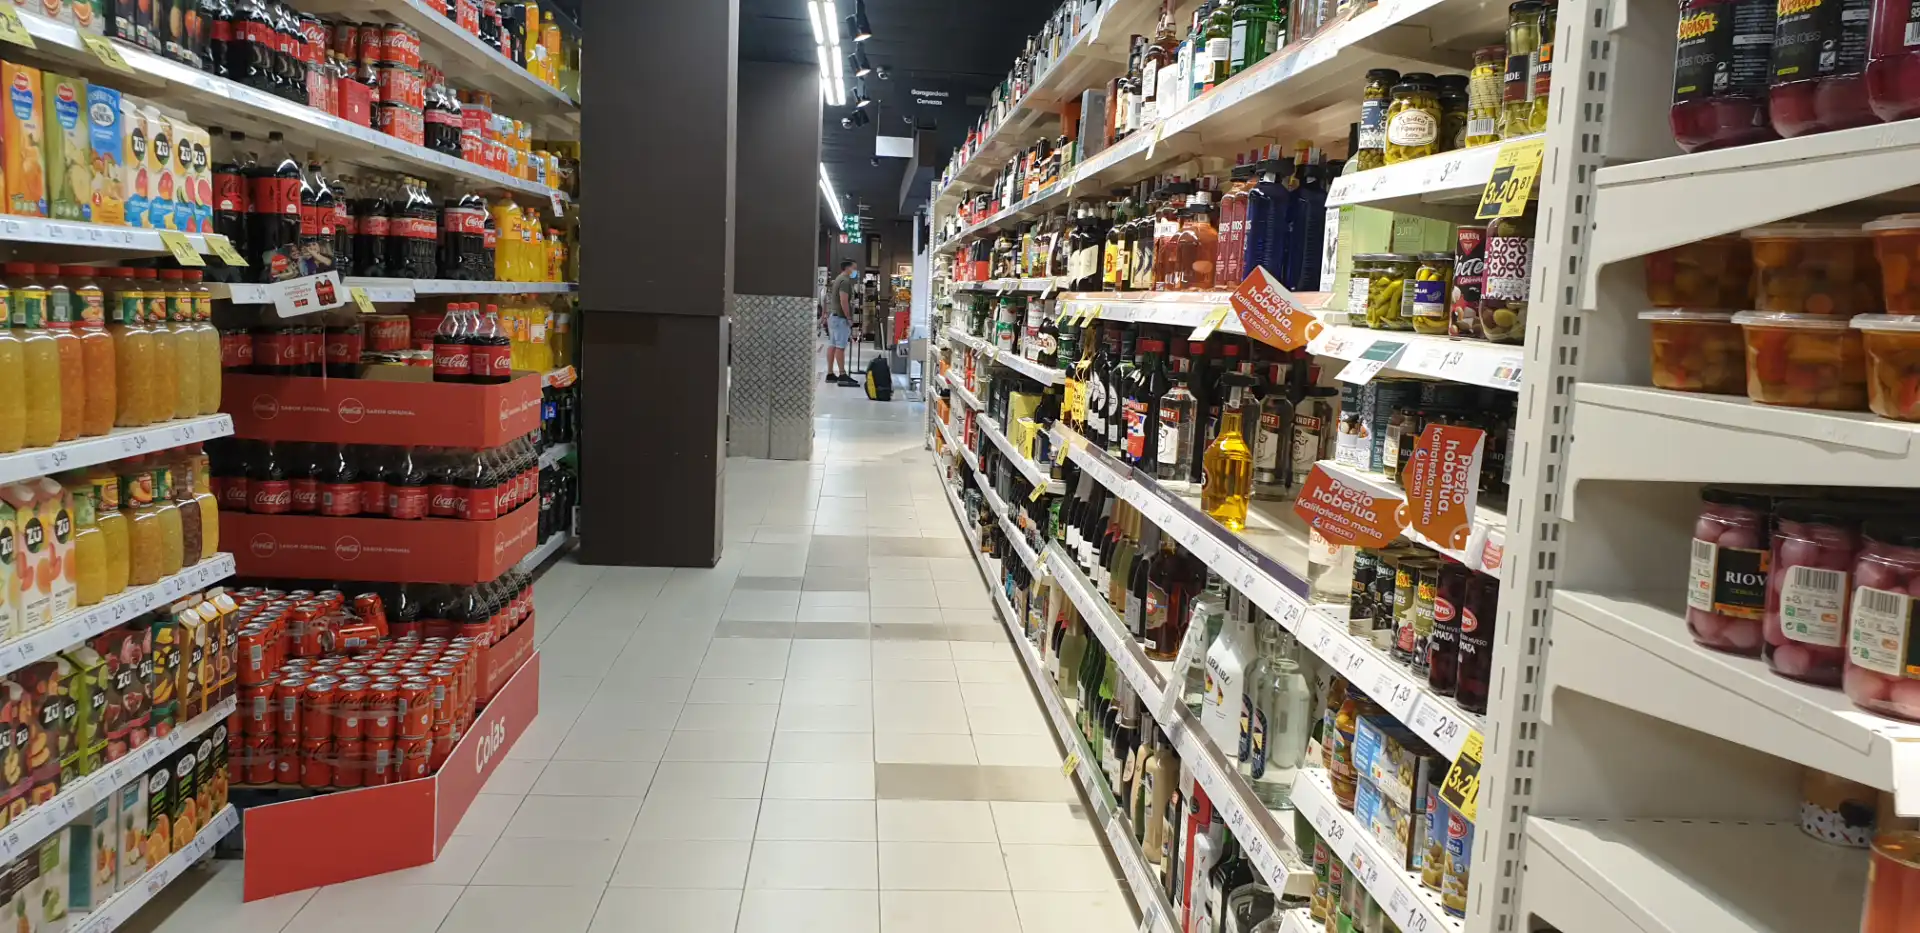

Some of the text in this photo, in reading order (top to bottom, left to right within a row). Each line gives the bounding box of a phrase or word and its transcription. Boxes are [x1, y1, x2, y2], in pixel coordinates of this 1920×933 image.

[1234, 291, 1292, 344] Kalitatezko marka
[1248, 285, 1292, 331] hobetua.
[1262, 284, 1293, 315] Prezio
[1329, 480, 1373, 507] Prezio
[1414, 463, 1424, 495] EROSKI
[1422, 427, 1444, 525] Kalitatezko marka
[1437, 440, 1460, 516] hobetua.
[1452, 455, 1472, 504] Prezio
[1297, 497, 1349, 525] Kalitatezko
[1351, 521, 1383, 539] marka
[1312, 486, 1378, 524] hobetua.
[1324, 522, 1354, 539] EROSKI
[476, 715, 505, 774] Colas
